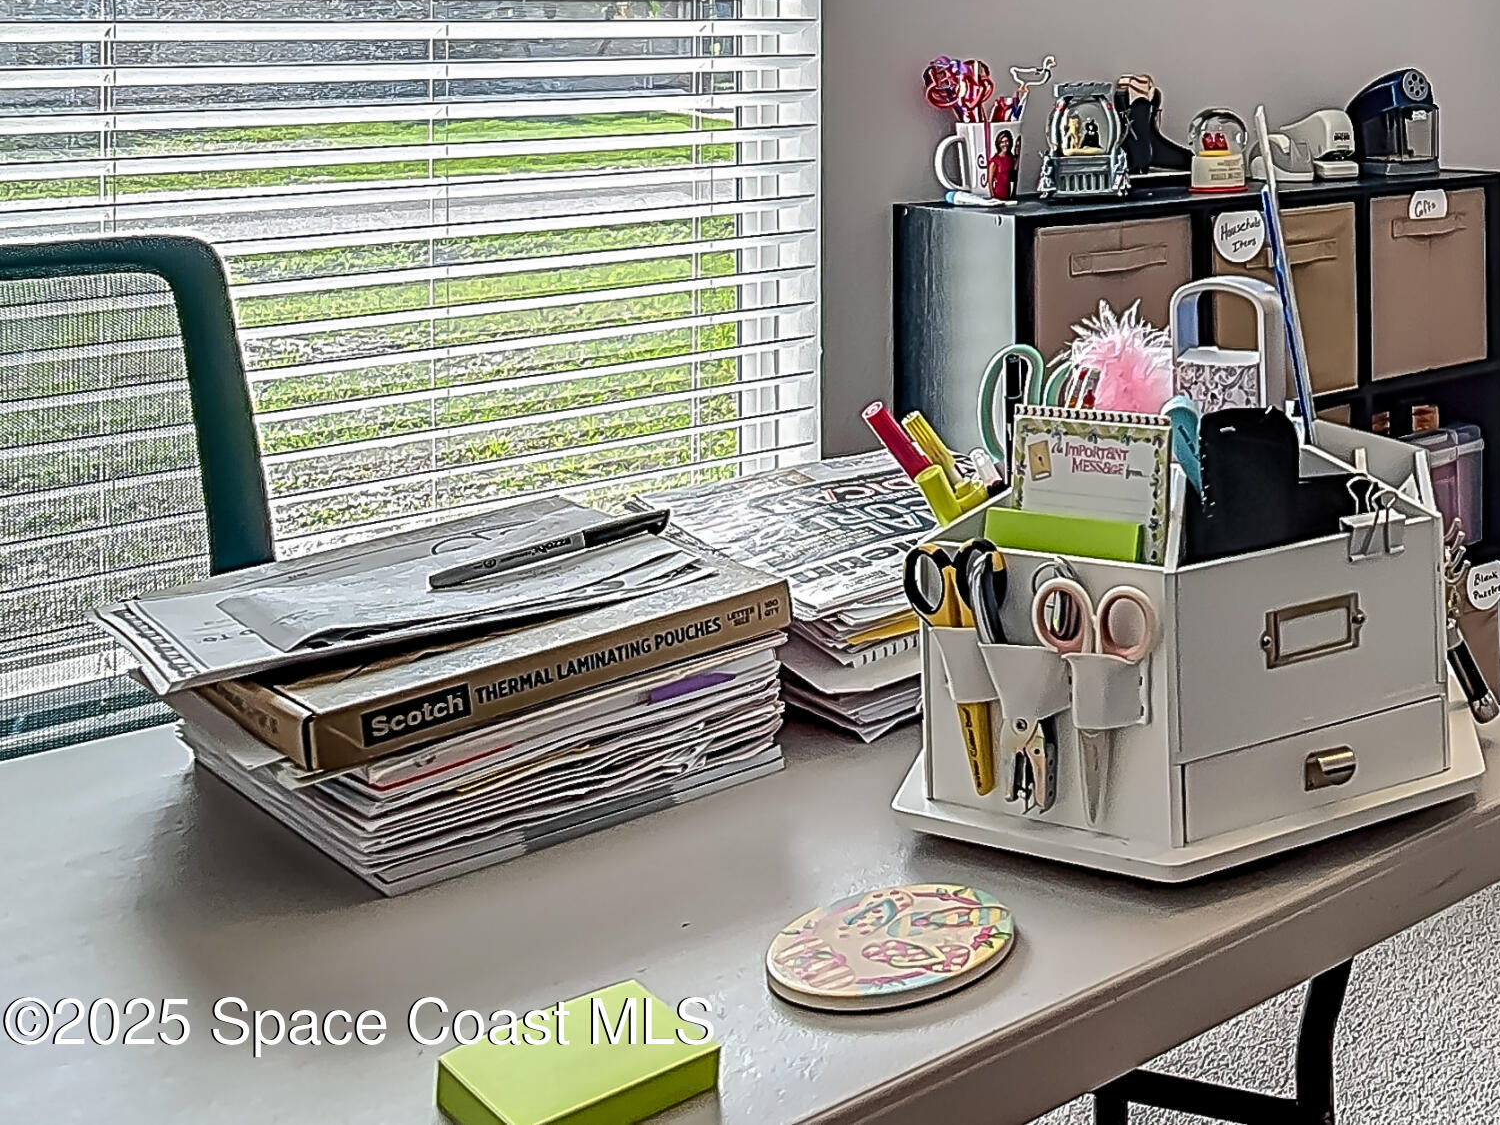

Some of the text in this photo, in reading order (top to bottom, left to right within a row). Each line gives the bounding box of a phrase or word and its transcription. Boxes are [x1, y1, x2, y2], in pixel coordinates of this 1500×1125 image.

[371, 617, 722, 737] Scotch THERMAL LAMINATING POUCHES
